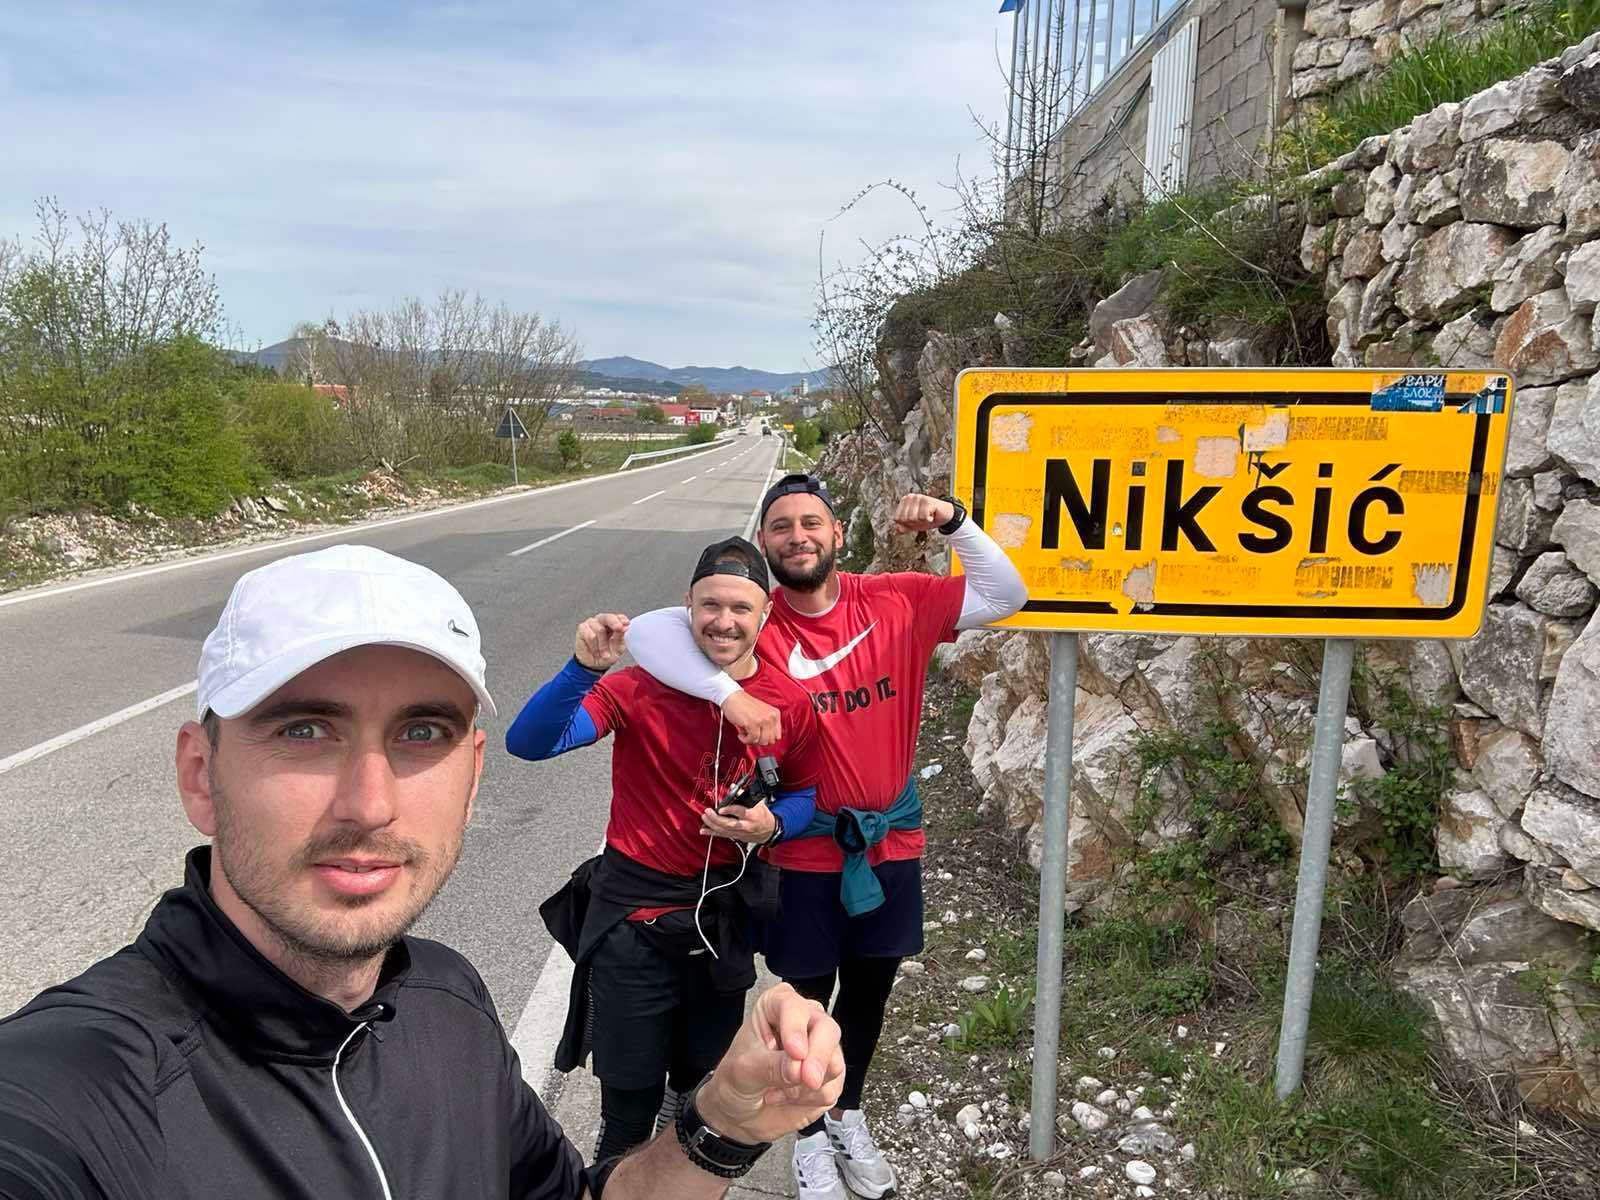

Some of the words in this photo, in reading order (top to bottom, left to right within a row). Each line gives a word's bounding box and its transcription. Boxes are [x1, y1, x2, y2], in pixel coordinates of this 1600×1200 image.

[1040, 458, 1405, 555] Nikšić
[844, 686, 871, 713] DO
[876, 676, 897, 702] IT.
